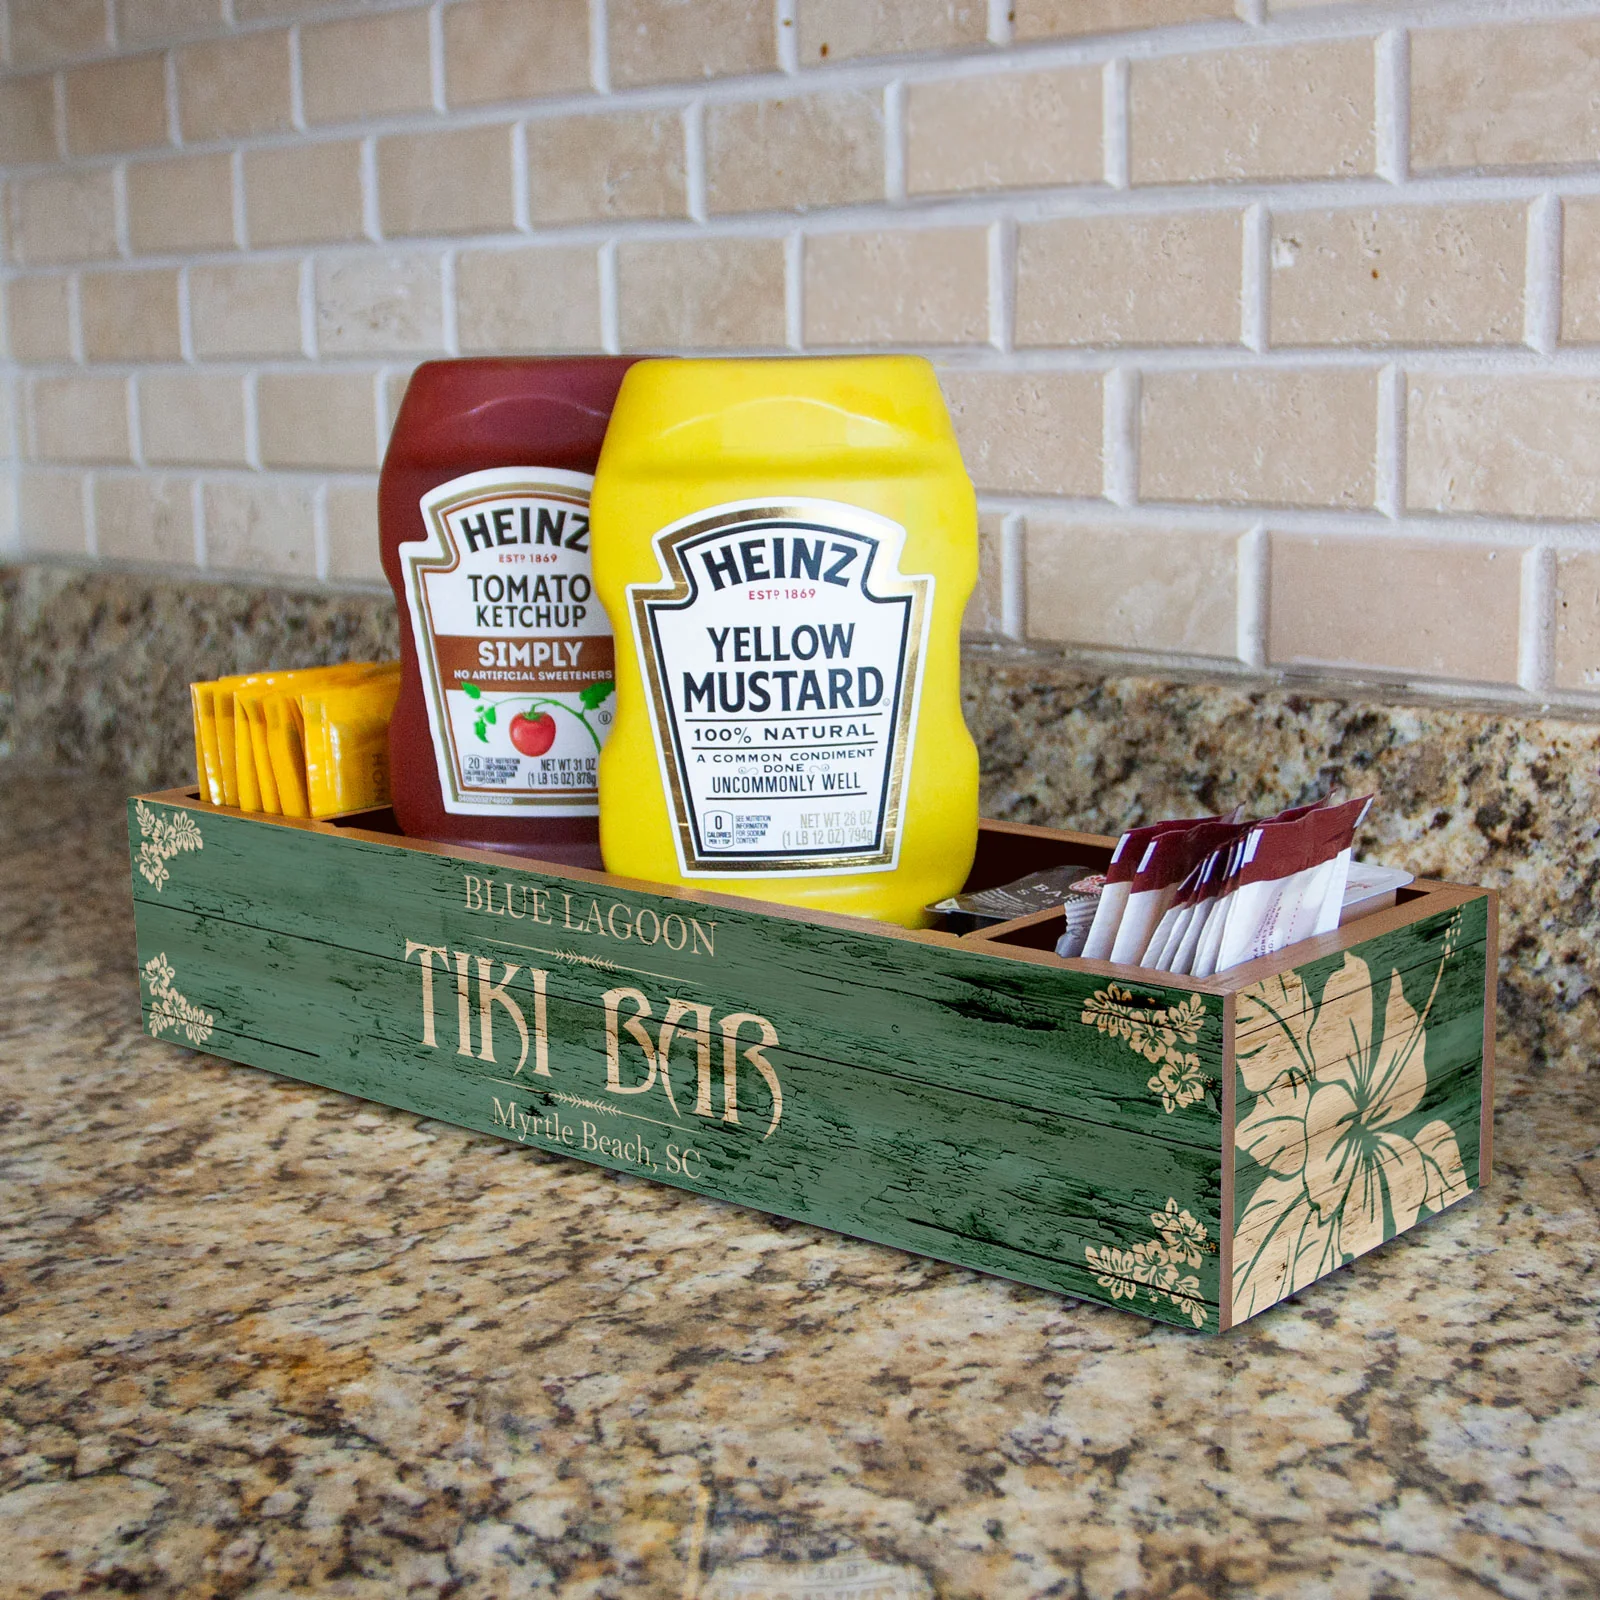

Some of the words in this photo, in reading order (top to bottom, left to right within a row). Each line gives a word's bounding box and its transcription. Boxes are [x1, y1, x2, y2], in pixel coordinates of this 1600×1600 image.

[459, 506, 590, 554] HEINZ
[530, 553, 558, 563] 1869
[700, 537, 858, 591] HEINZ
[467, 574, 591, 603] TOMATO
[784, 588, 816, 600] 1869
[476, 605, 587, 628] KETCHUP
[706, 622, 855, 662] YELLOW
[478, 641, 584, 667] SIMPLY
[454, 670, 469, 679] NO
[472, 670, 535, 680] ARTIFICIAL
[538, 670, 613, 680] SWEETENERS
[682, 666, 884, 713] MUSTARD
[694, 727, 752, 744] 100%
[764, 723, 875, 741] NATURAL
[468, 757, 480, 769] 20
[541, 759, 555, 771] NET
[558, 758, 571, 771] WT
[574, 758, 581, 771] 31
[585, 758, 596, 771] OZ
[696, 754, 706, 763] A
[713, 753, 783, 763] COMMON
[790, 748, 875, 762] CONDIMENT
[528, 772, 535, 787] (1
[538, 773, 548, 785] LB
[551, 772, 559, 785] 15
[561, 772, 575, 787] OZ)
[763, 764, 805, 773] DONE
[712, 774, 816, 794] UNCOMMONLY
[822, 772, 861, 790] WELL
[715, 815, 722, 830] 0
[800, 813, 820, 829] NET
[823, 811, 841, 828] WT
[860, 810, 873, 825] OZ
[782, 830, 791, 849] (1
[796, 830, 808, 846] LB
[813, 830, 824, 844] 12
[828, 828, 845, 846] OZ)
[848, 827, 873, 845] 794g
[464, 874, 552, 925] BLUE
[564, 894, 718, 957] LAGOON
[405, 938, 552, 1077] TIKI
[600, 987, 784, 1141] BAR
[491, 1096, 574, 1142] Myrtle
[581, 1120, 658, 1172] Beach,
[666, 1143, 702, 1179] SC
